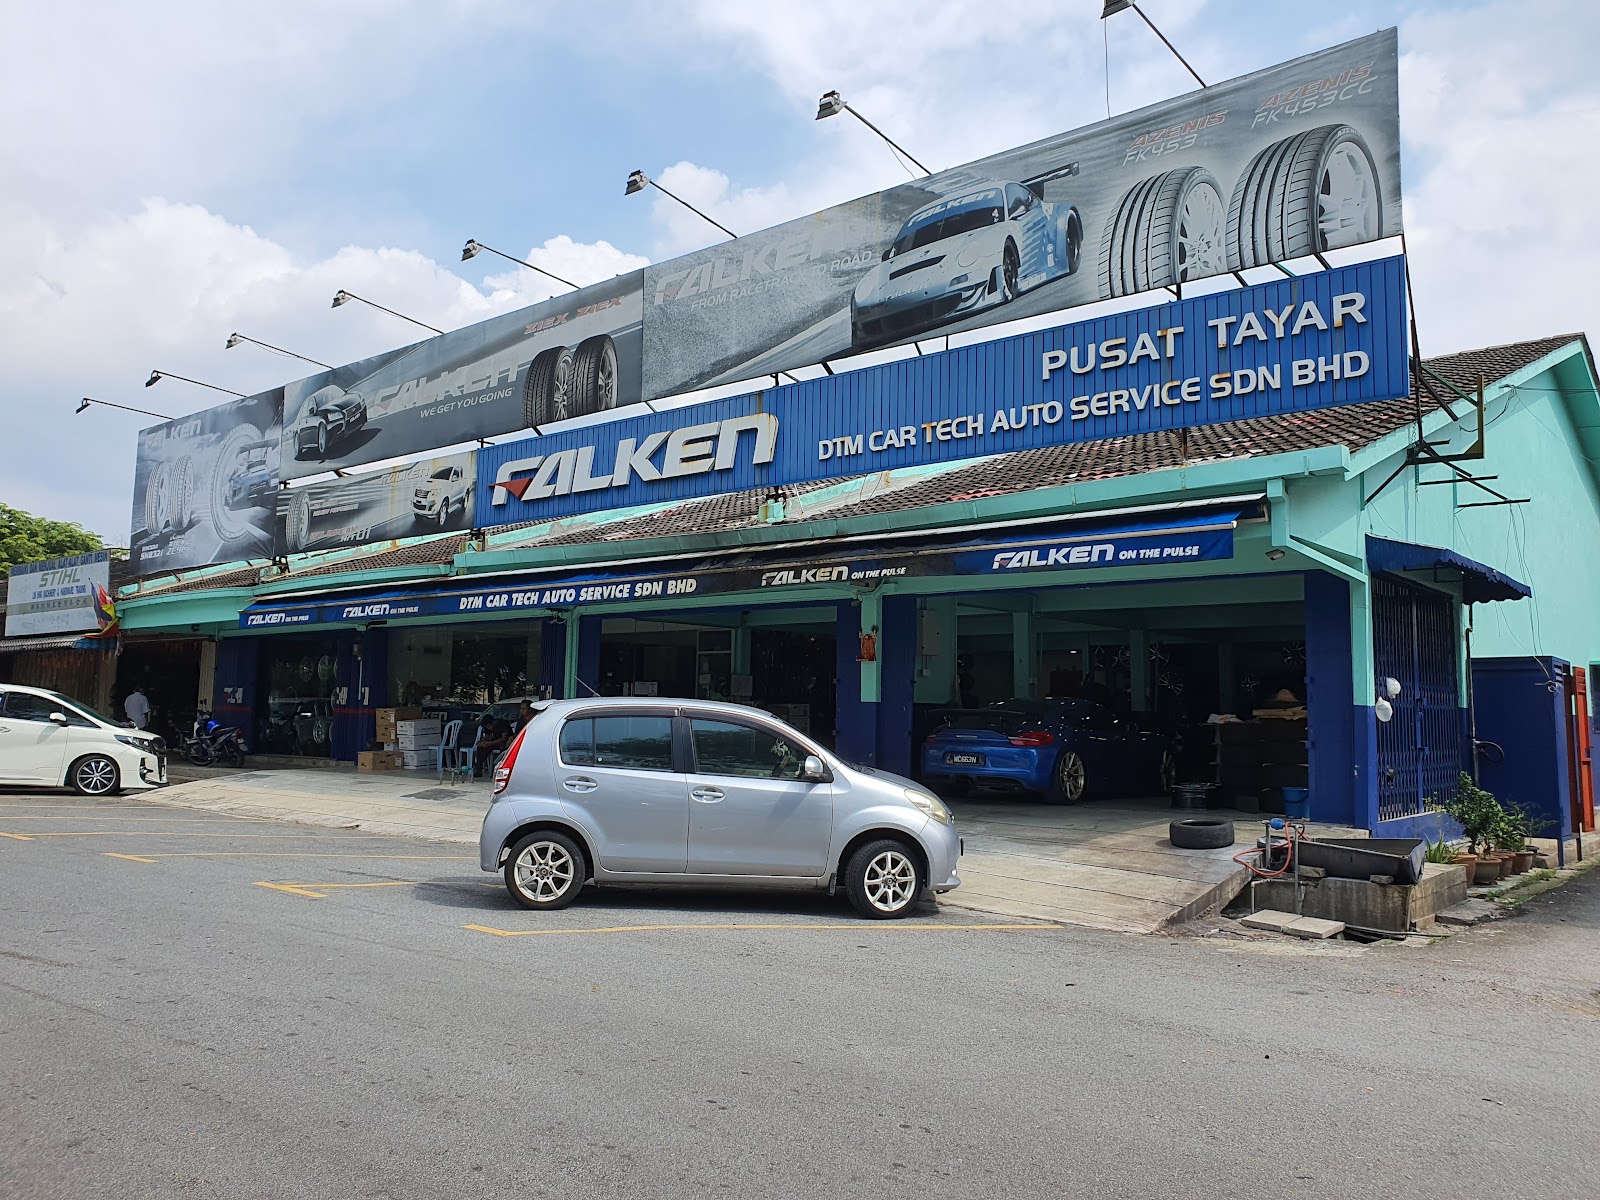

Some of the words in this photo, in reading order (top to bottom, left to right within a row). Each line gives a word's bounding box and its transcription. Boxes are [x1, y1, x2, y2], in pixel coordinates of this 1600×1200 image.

[1250, 76, 1378, 129] FK453CC
[1255, 61, 1375, 114] AZENIS
[1127, 110, 1229, 151] AZENIS
[1122, 133, 1199, 166] FK453
[907, 190, 997, 227] FALKEN
[690, 295, 727, 312] FROM
[730, 269, 807, 301] RACETRAC
[830, 250, 872, 271] ROAD
[524, 312, 569, 335] ZIEX
[576, 295, 625, 318] ZIEX
[1042, 325, 1184, 381] PUSAT
[1208, 292, 1368, 349] TAYAR
[372, 354, 520, 419] FALKEN
[420, 406, 436, 418] WE
[437, 401, 455, 414] GET
[457, 398, 478, 409] YOU
[479, 388, 513, 403] GOING
[818, 434, 864, 461] DTM
[869, 425, 917, 453] CAR
[922, 412, 984, 443] TECH
[989, 400, 1063, 433] AUTO
[1070, 376, 1201, 421] SERVICE
[1209, 363, 1281, 399] SDN
[1292, 350, 1370, 387] BHD
[379, 467, 430, 485] FALKEN
[489, 412, 780, 506] FALKEN
[990, 543, 1115, 570] FALKEN
[1118, 549, 1138, 561] ON
[1139, 548, 1160, 559] THE
[1162, 545, 1199, 557] PULSE
[39, 567, 81, 588] STIHL
[459, 595, 483, 610] DTM
[486, 594, 508, 608] CAR
[511, 591, 540, 606] TECH
[541, 588, 576, 604] AUTO
[579, 583, 630, 601] SERVICE
[634, 580, 663, 597] SDN
[666, 578, 697, 595] BHD
[761, 565, 849, 587] FALKEN
[851, 570, 865, 580] ON
[865, 568, 880, 579] THE
[881, 567, 907, 577] PULSE
[248, 612, 285, 626] FALKEN
[342, 603, 390, 618] FALKEN
